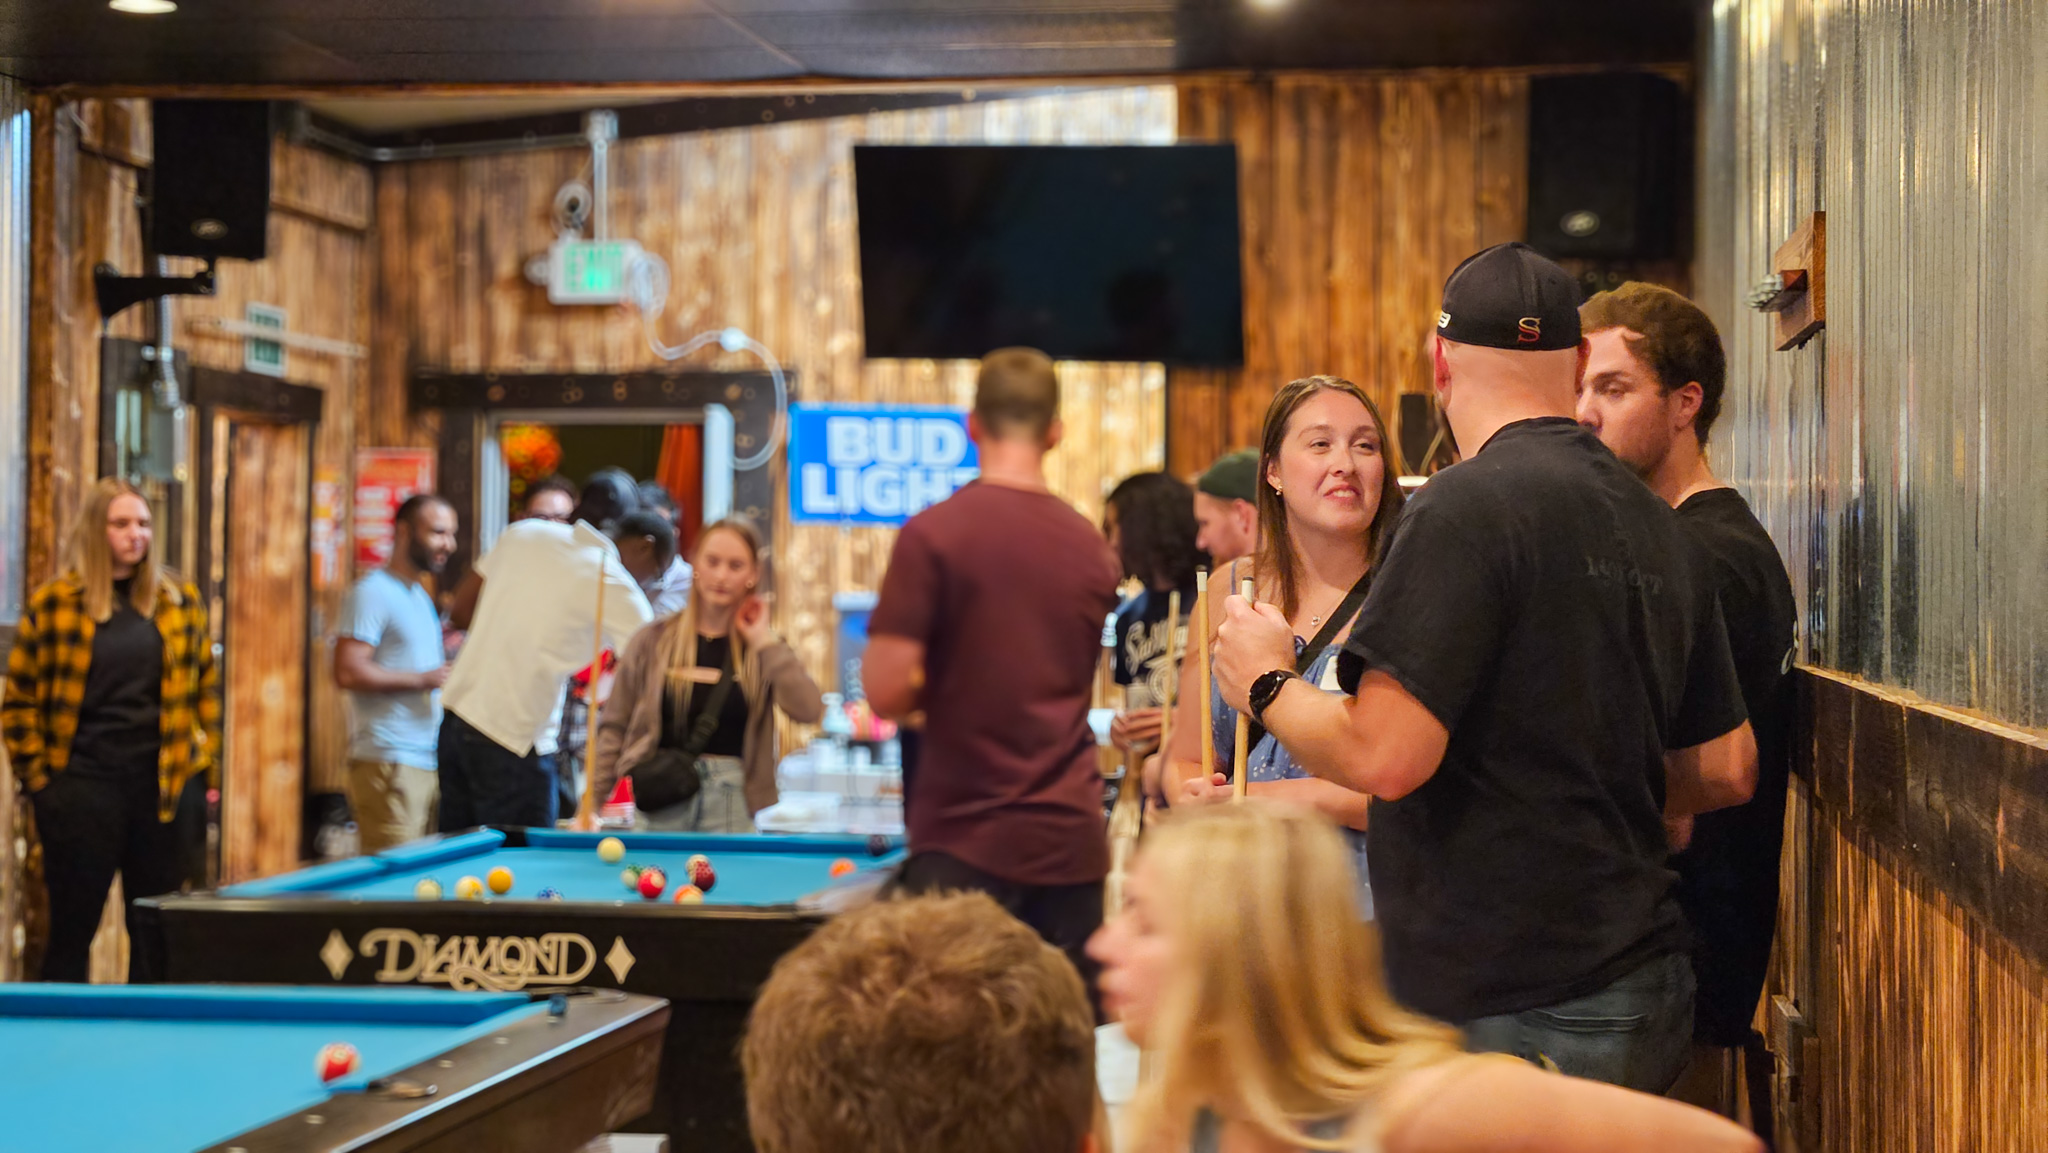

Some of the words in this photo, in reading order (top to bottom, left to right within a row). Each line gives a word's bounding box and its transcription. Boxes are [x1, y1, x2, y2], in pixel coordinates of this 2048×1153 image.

[1517, 317, 1541, 343] S
[826, 416, 968, 467] BUD
[359, 928, 597, 991] DIAMOND
